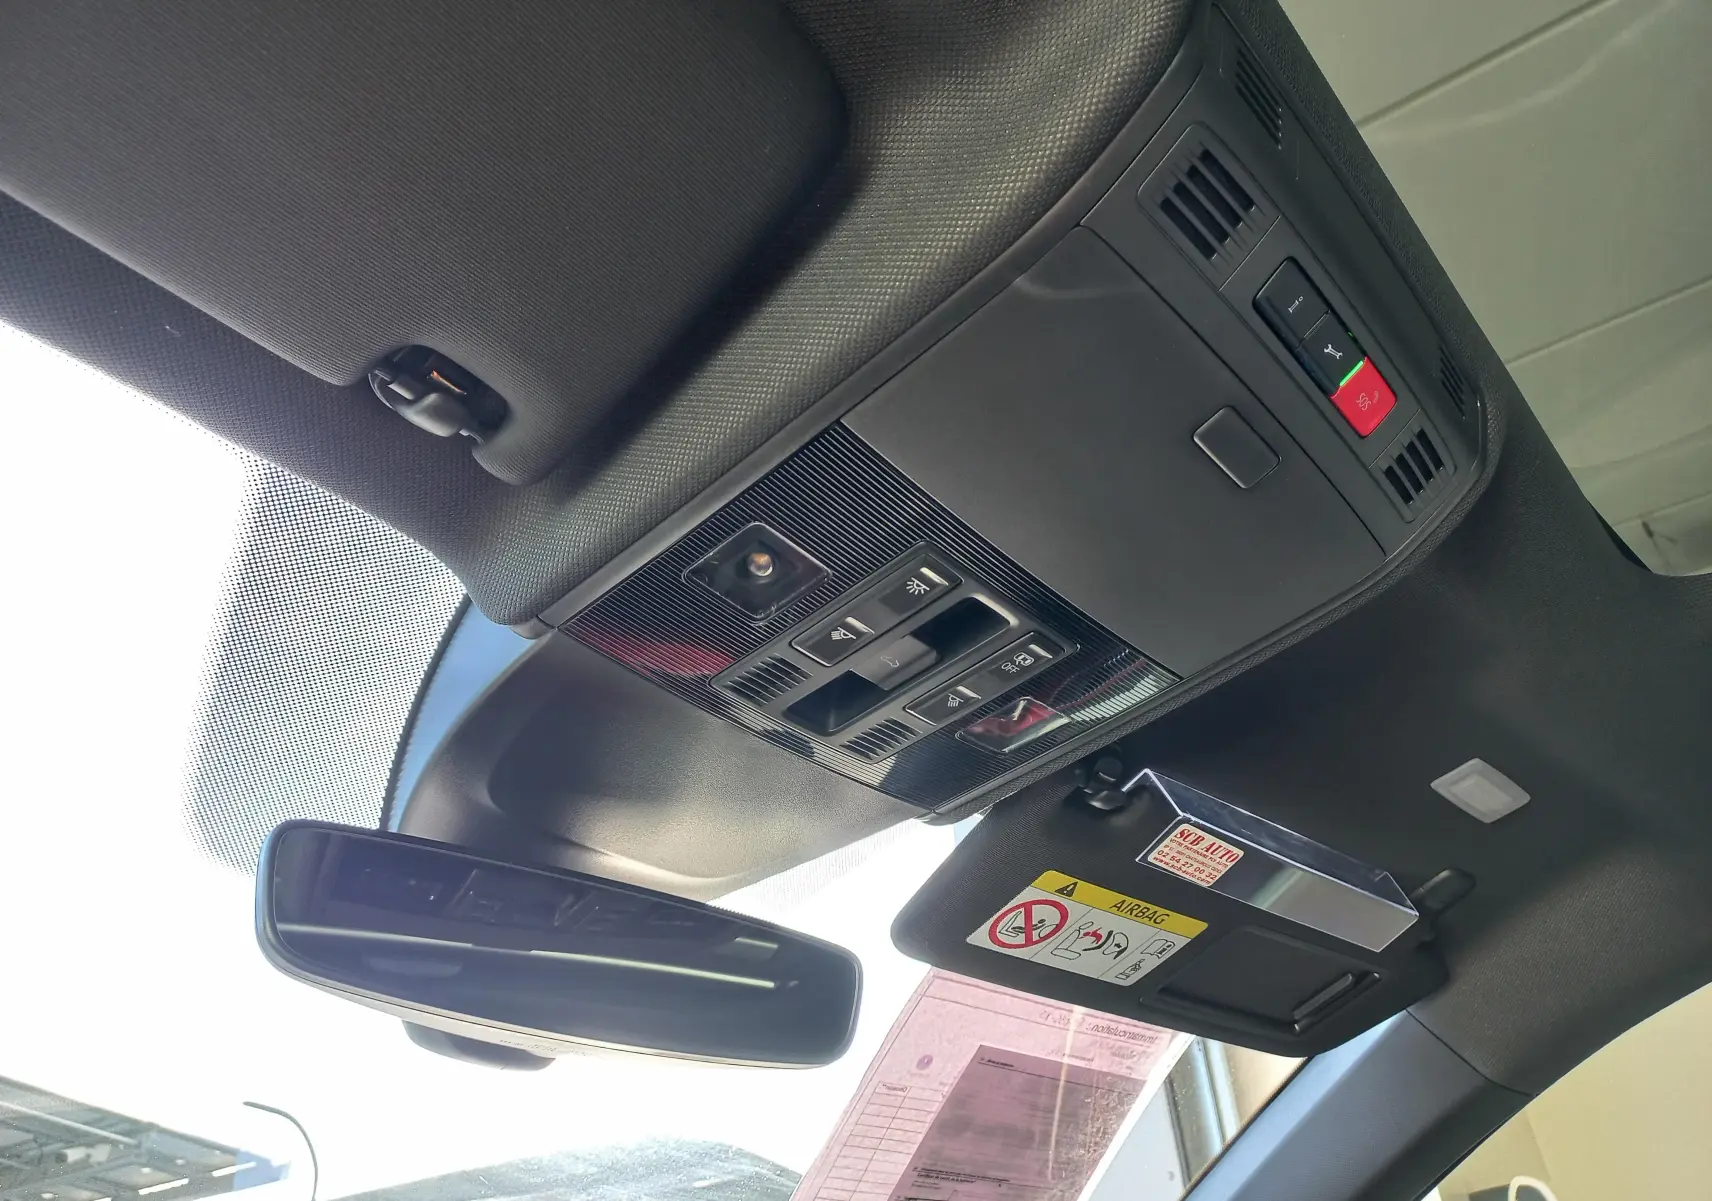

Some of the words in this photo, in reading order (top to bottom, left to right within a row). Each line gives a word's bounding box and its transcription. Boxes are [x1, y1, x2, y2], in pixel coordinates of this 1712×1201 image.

[1001, 662, 1020, 674] OFF
[1175, 828, 1205, 846] SCB
[1200, 841, 1240, 863] AUTO
[1153, 856, 1211, 884] www.scb-auto.com
[1156, 849, 1170, 858] 02
[1168, 855, 1182, 863] 54
[1181, 861, 1193, 869] 27
[1192, 866, 1205, 874] 00
[1204, 872, 1217, 880] 32
[1109, 899, 1170, 925] AIRBAG
